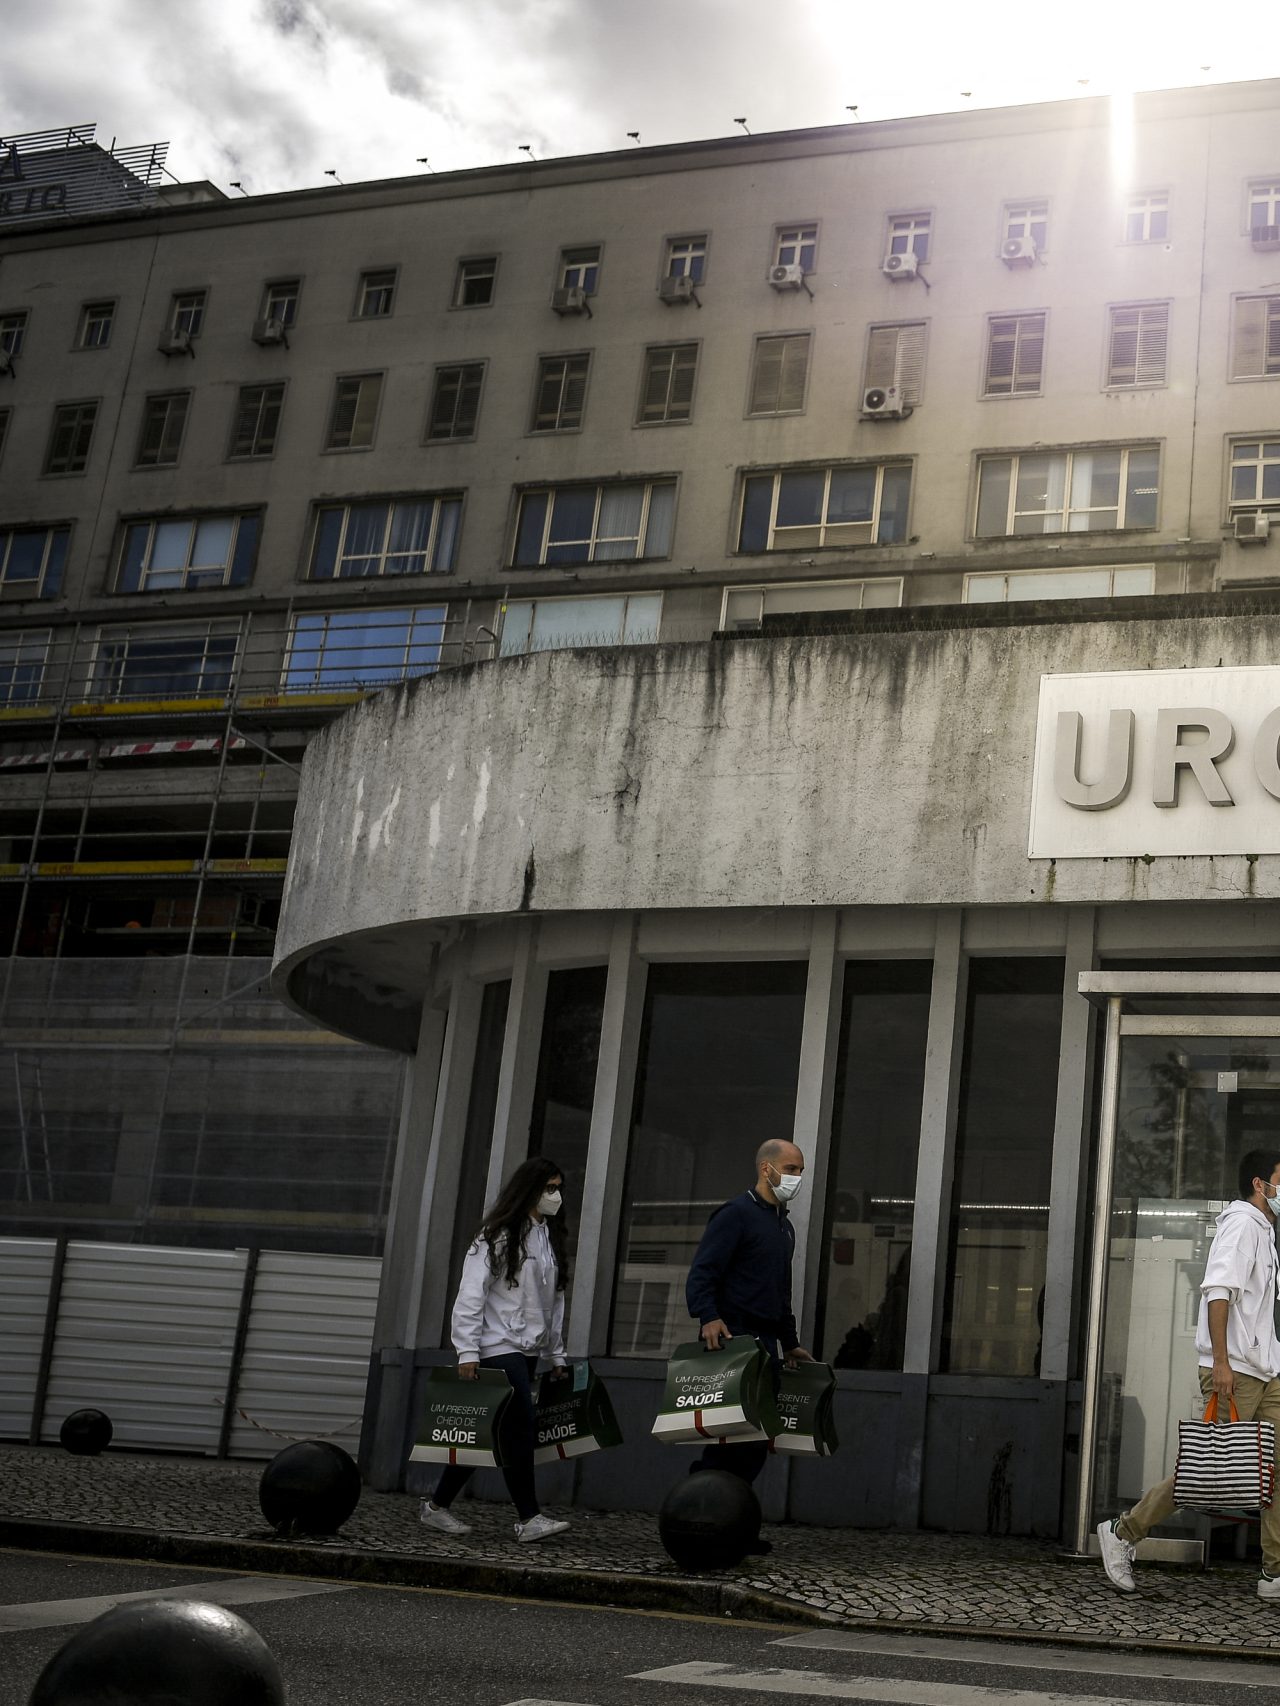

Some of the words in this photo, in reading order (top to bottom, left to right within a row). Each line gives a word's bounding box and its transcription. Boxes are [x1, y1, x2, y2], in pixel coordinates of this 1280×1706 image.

[675, 1375, 691, 1383] UM
[692, 1369, 737, 1383] PRESENTE
[681, 1384, 711, 1392] CHEIO
[712, 1381, 725, 1390] DE
[676, 1391, 724, 1408] SAÚDE
[777, 1393, 811, 1404] ESENTE
[430, 1403, 445, 1413] UM
[445, 1404, 488, 1416] PRESENTE
[436, 1415, 463, 1426] CHEIO
[463, 1417, 477, 1427] DE
[432, 1427, 477, 1444] SAÚDE
[538, 1423, 577, 1443] SAÚDE
